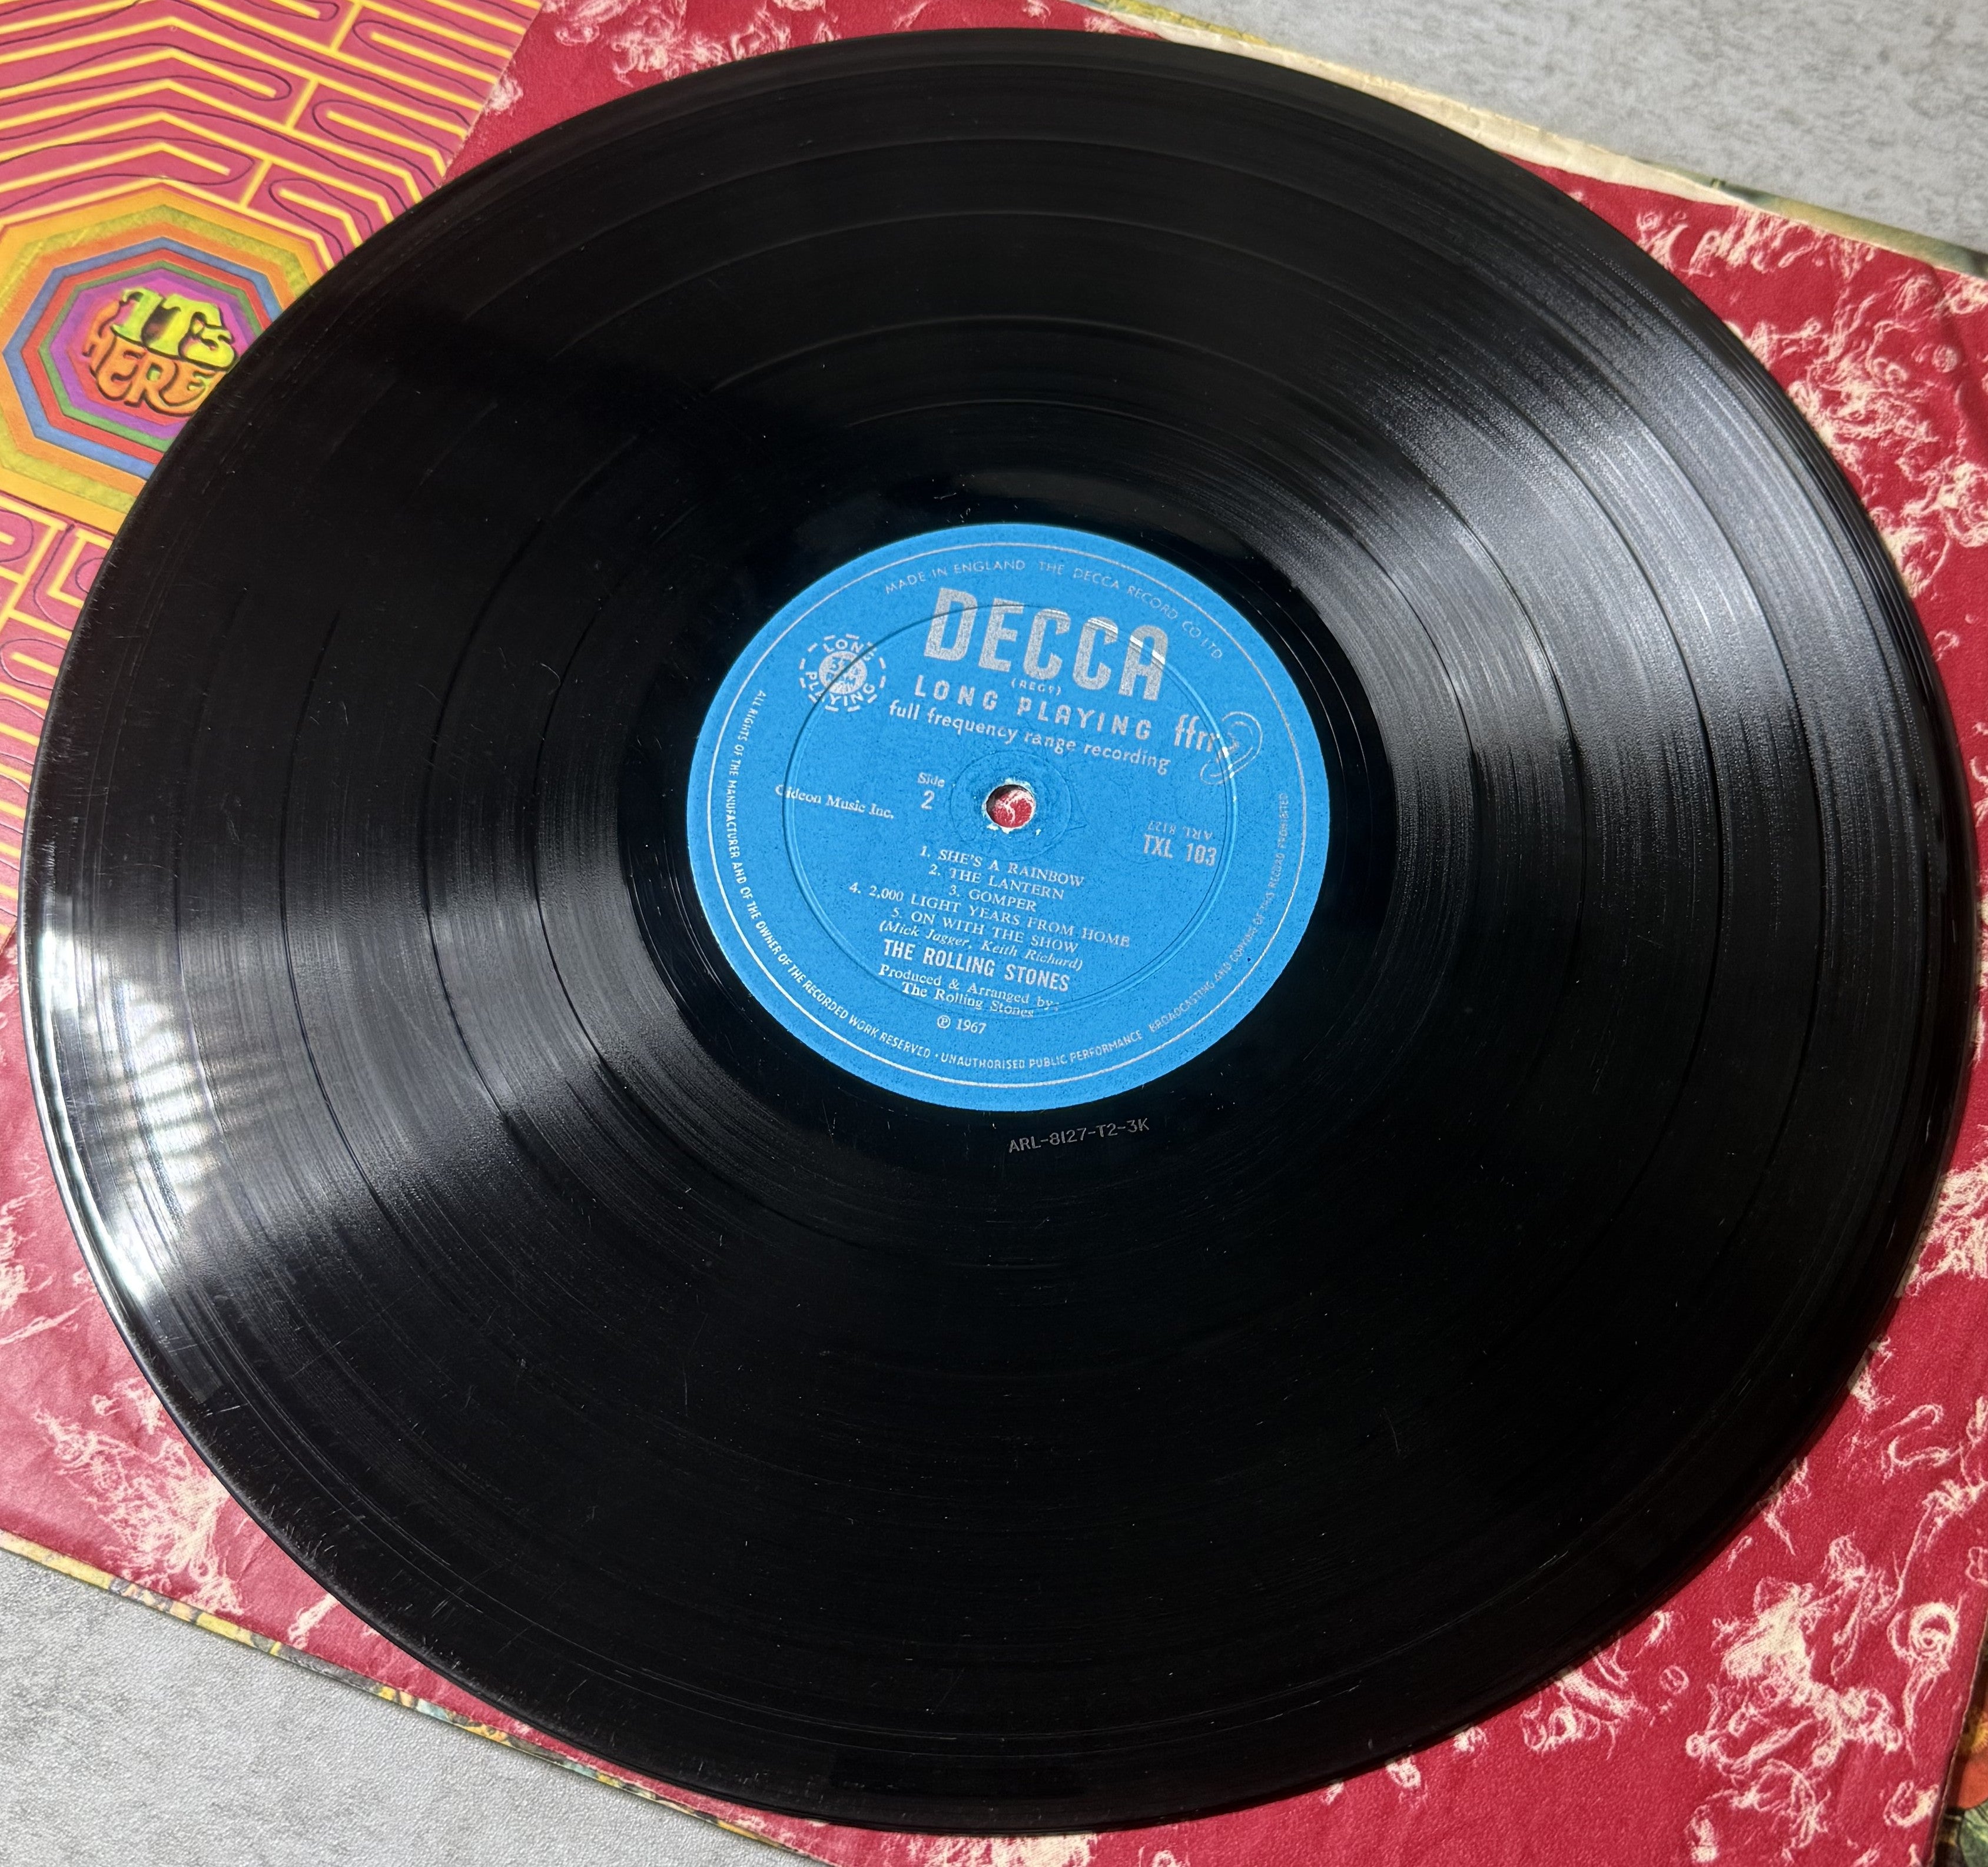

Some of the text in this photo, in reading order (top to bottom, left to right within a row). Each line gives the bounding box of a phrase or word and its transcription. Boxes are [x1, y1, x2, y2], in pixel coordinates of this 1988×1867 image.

[82, 299, 231, 417] HERE
[885, 572, 927, 594] MADE
[931, 567, 948, 578] IN
[954, 560, 1025, 574] ENGLAND
[1038, 561, 1065, 575] THE
[1073, 568, 1119, 589] DECCA
[1127, 586, 1178, 619] RECORD
[923, 587, 1169, 702] DECCA
[805, 671, 875, 706] PLAYING
[914, 675, 1152, 740] LONG PLAYING
[889, 699, 1171, 776] full frequency range recording
[917, 772, 945, 788] Side
[920, 789, 935, 810] 2
[775, 784, 895, 819] Gideon Music Inc.
[1143, 833, 1217, 867] TXL 103
[1147, 820, 1213, 841] ARL 8127
[726, 690, 931, 1059] ALL RIGHTS OF THE MANUFACTURER AND OF THE OWNER OF THE RECORDED WORK RESERVED
[920, 845, 1085, 887] 1. SHE'S A RAINBOW
[928, 863, 1064, 900] 2. THE LANTERN
[849, 882, 1130, 948] 4. 2,000 LIGHT YEARS FROM HOME
[948, 885, 1037, 912] 3. GOMPER
[879, 920, 1083, 971] (Mick Jagger, Keith Richard)
[891, 907, 1078, 953] 5. ON WITH THE SHOW
[878, 964, 942, 986] Produced
[948, 979, 960, 991] &
[967, 982, 1030, 1004] Arranged
[883, 938, 1070, 992] THE ROLLING STONES
[902, 981, 1034, 1018] The Rolling Stones
[1149, 981, 1214, 1034] BROADCASTING
[955, 1018, 987, 1035] 1967
[941, 1030, 1143, 1069] UNAUTHORISED PUBLIC PERFORMANCE
